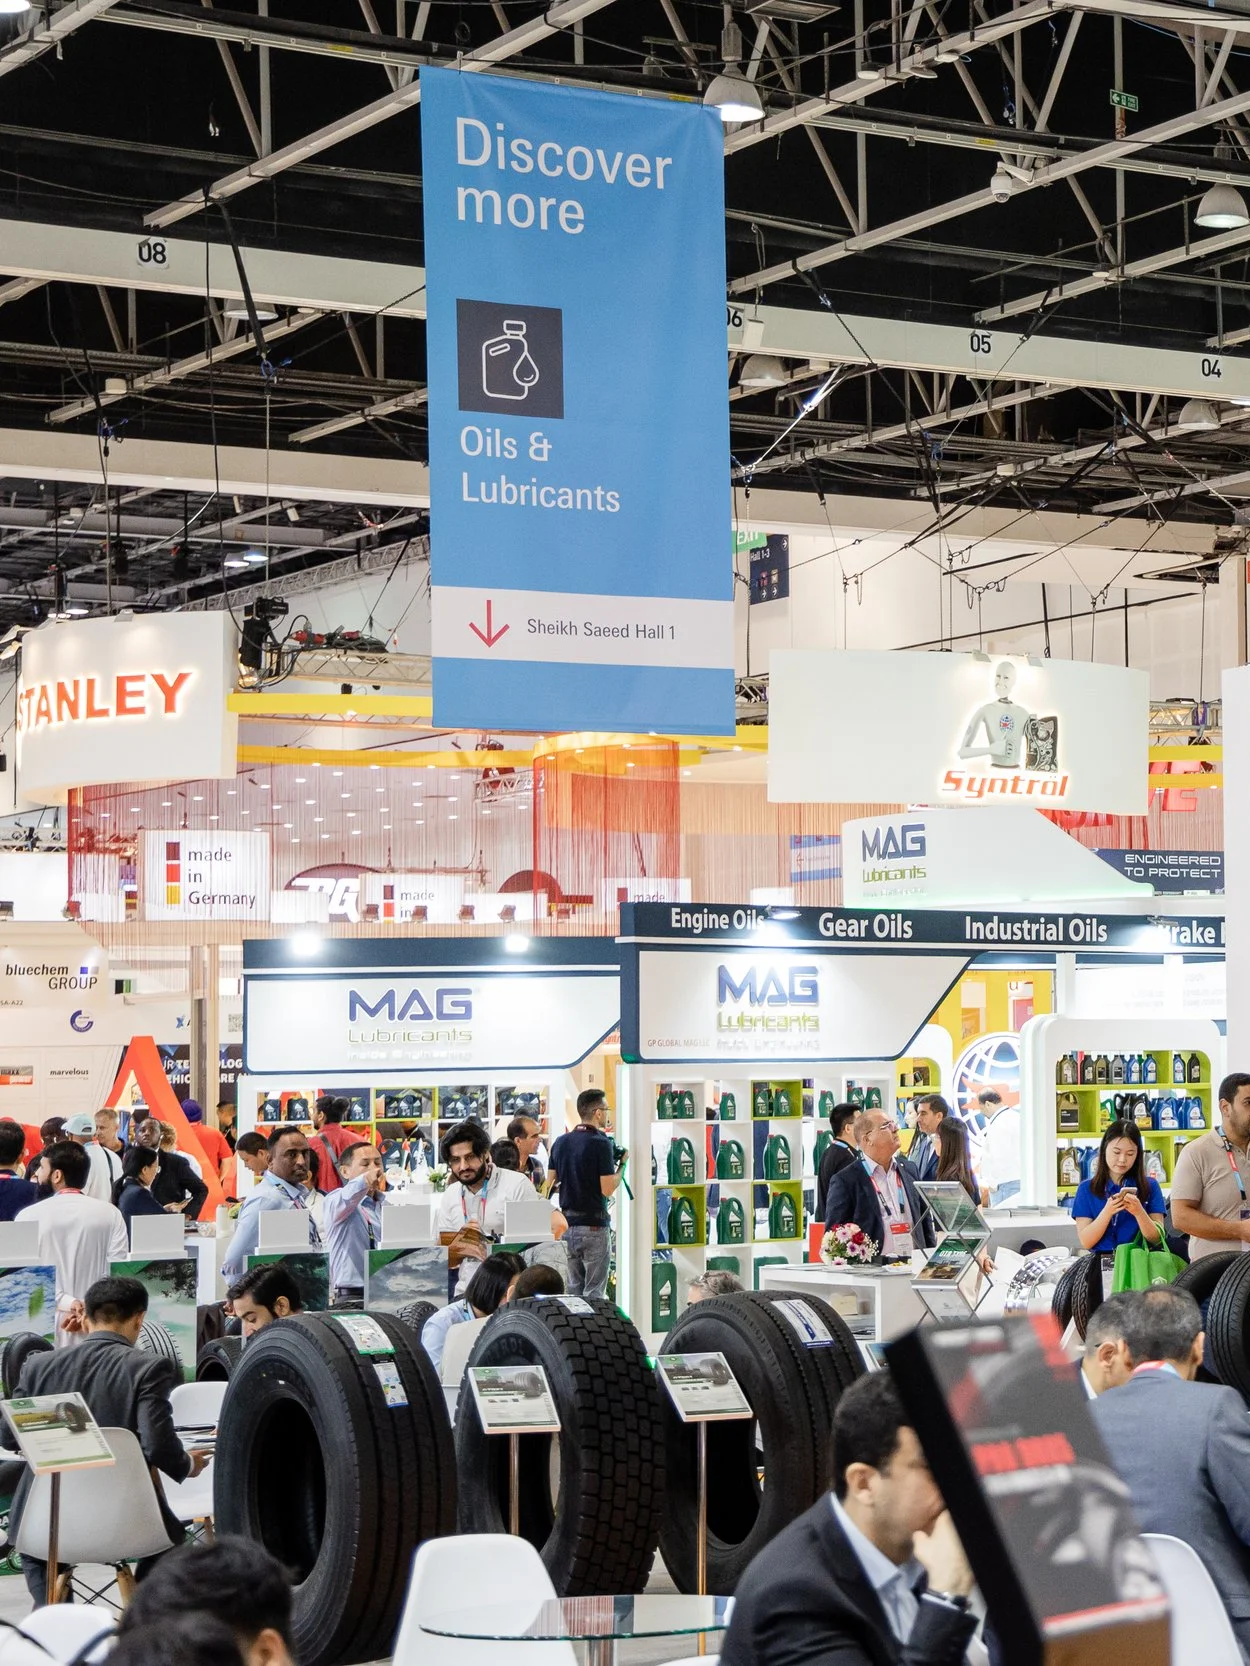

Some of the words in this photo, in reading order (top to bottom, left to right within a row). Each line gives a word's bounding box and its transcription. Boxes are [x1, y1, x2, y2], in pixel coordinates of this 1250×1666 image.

[457, 117, 672, 189] Discover
[457, 187, 586, 235] more
[138, 242, 167, 265] 08
[726, 309, 743, 328] 6
[970, 334, 991, 354] 05
[1201, 358, 1222, 378] 04
[460, 426, 518, 462] Oils
[529, 434, 553, 463] &
[461, 473, 621, 513] Lubricants
[527, 617, 578, 637] Sheikh
[582, 619, 631, 638] Saeed
[635, 622, 664, 639] Hall
[669, 623, 676, 640] 1
[17, 672, 193, 734] STANLEY
[862, 823, 926, 862] MAG
[188, 847, 232, 862] made
[1125, 853, 1221, 865] ENGINEERED
[188, 869, 202, 883] in
[862, 865, 927, 883] Lubricants
[1124, 867, 1145, 877] TO
[1149, 868, 1221, 878] PROTECT
[188, 890, 256, 909] Germany
[401, 888, 434, 901] made
[671, 907, 730, 934] Engine
[733, 909, 765, 931] Oils
[818, 912, 869, 938] Gear
[873, 913, 913, 940] Oils
[965, 916, 1061, 942] Industrial
[1067, 917, 1108, 944] Oils
[5, 964, 69, 976] bluechem
[48, 976, 98, 990] GROUP
[717, 964, 820, 1006] MAG
[349, 988, 473, 1022] MAG
[716, 1011, 820, 1034] Lubricants
[349, 1027, 473, 1043] Lubricants
[658, 1039, 682, 1047] GLOBAL
[50, 1067, 89, 1076] marvelous
